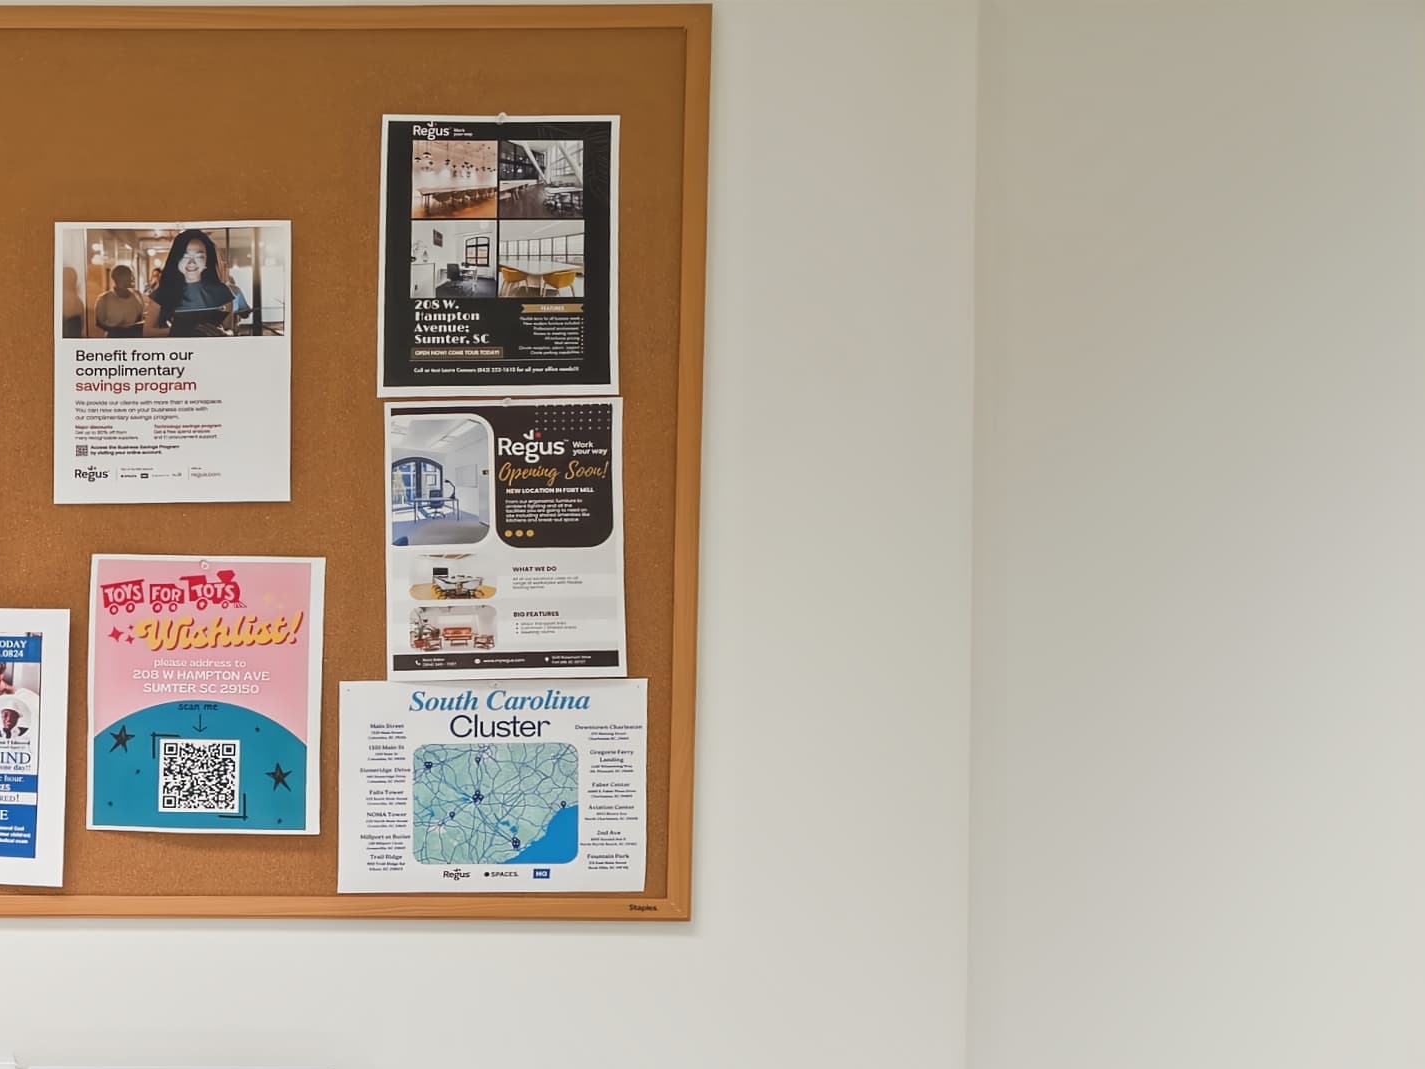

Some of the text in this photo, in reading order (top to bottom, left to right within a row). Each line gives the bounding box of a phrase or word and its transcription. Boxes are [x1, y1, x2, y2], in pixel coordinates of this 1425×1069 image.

[413, 123, 450, 140] Regus
[415, 300, 459, 310] 208 W.
[415, 312, 480, 323] Hampton
[473, 334, 490, 344] SC
[76, 350, 194, 361] Benefit from our
[76, 365, 185, 379] complimentary
[76, 380, 197, 394] savings program
[498, 436, 565, 463] Regus
[74, 467, 109, 482] Regus
[499, 460, 609, 487] Opening Soon!
[104, 583, 235, 601] TOYS FOR TOTS
[134, 609, 304, 651] Wishlist!
[154, 658, 186, 668] please
[190, 659, 231, 668] address
[133, 670, 270, 681] 208 W HAMPTON AVE
[143, 683, 259, 694] SUMTER SC 29150
[178, 703, 200, 711] scan
[409, 690, 590, 712] South Carolina
[450, 714, 550, 738] Cluster
[443, 870, 470, 880] Regus
